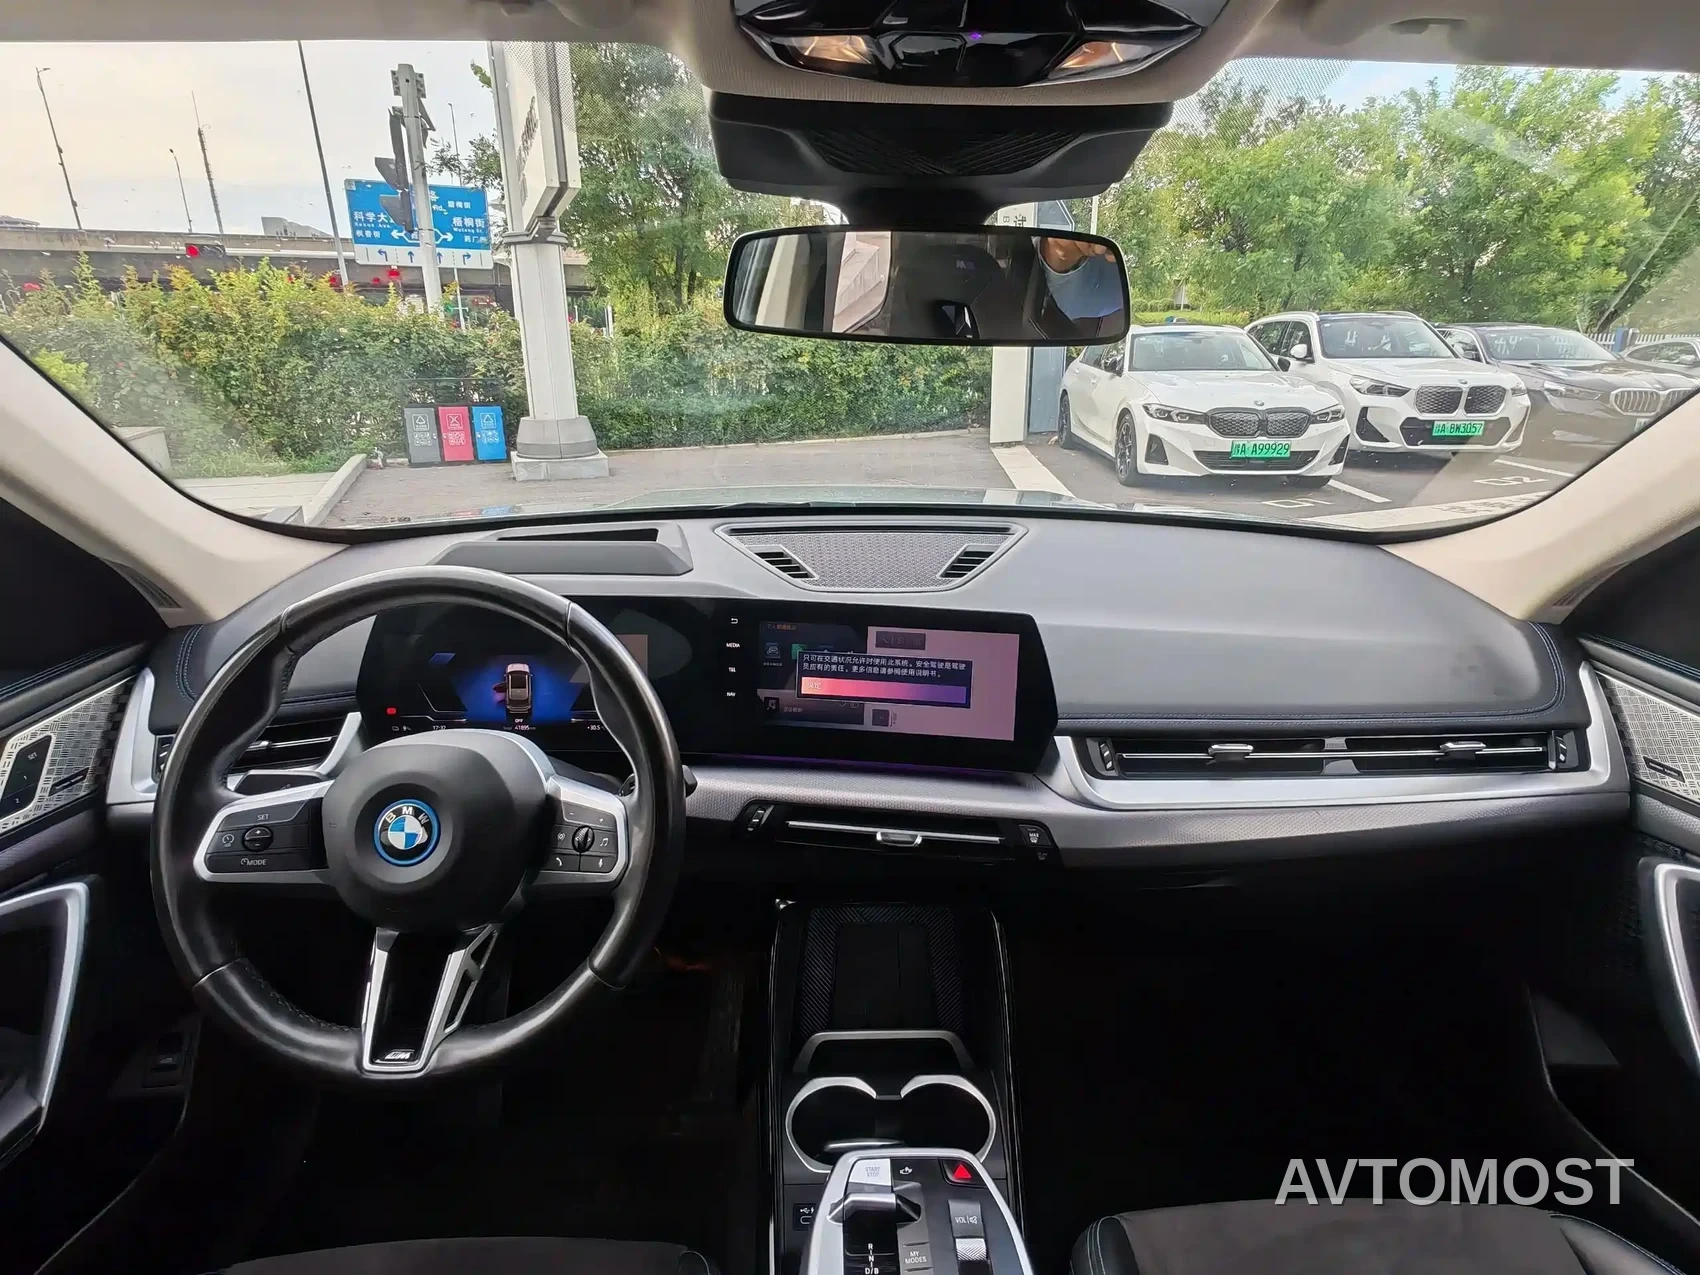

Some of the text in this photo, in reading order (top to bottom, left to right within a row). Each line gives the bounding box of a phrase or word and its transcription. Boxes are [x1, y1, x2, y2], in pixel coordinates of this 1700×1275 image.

[257, 813, 269, 821] SET
[385, 806, 430, 825] BMW
[246, 858, 267, 866] MODE
[904, 1256, 927, 1264] MODES
